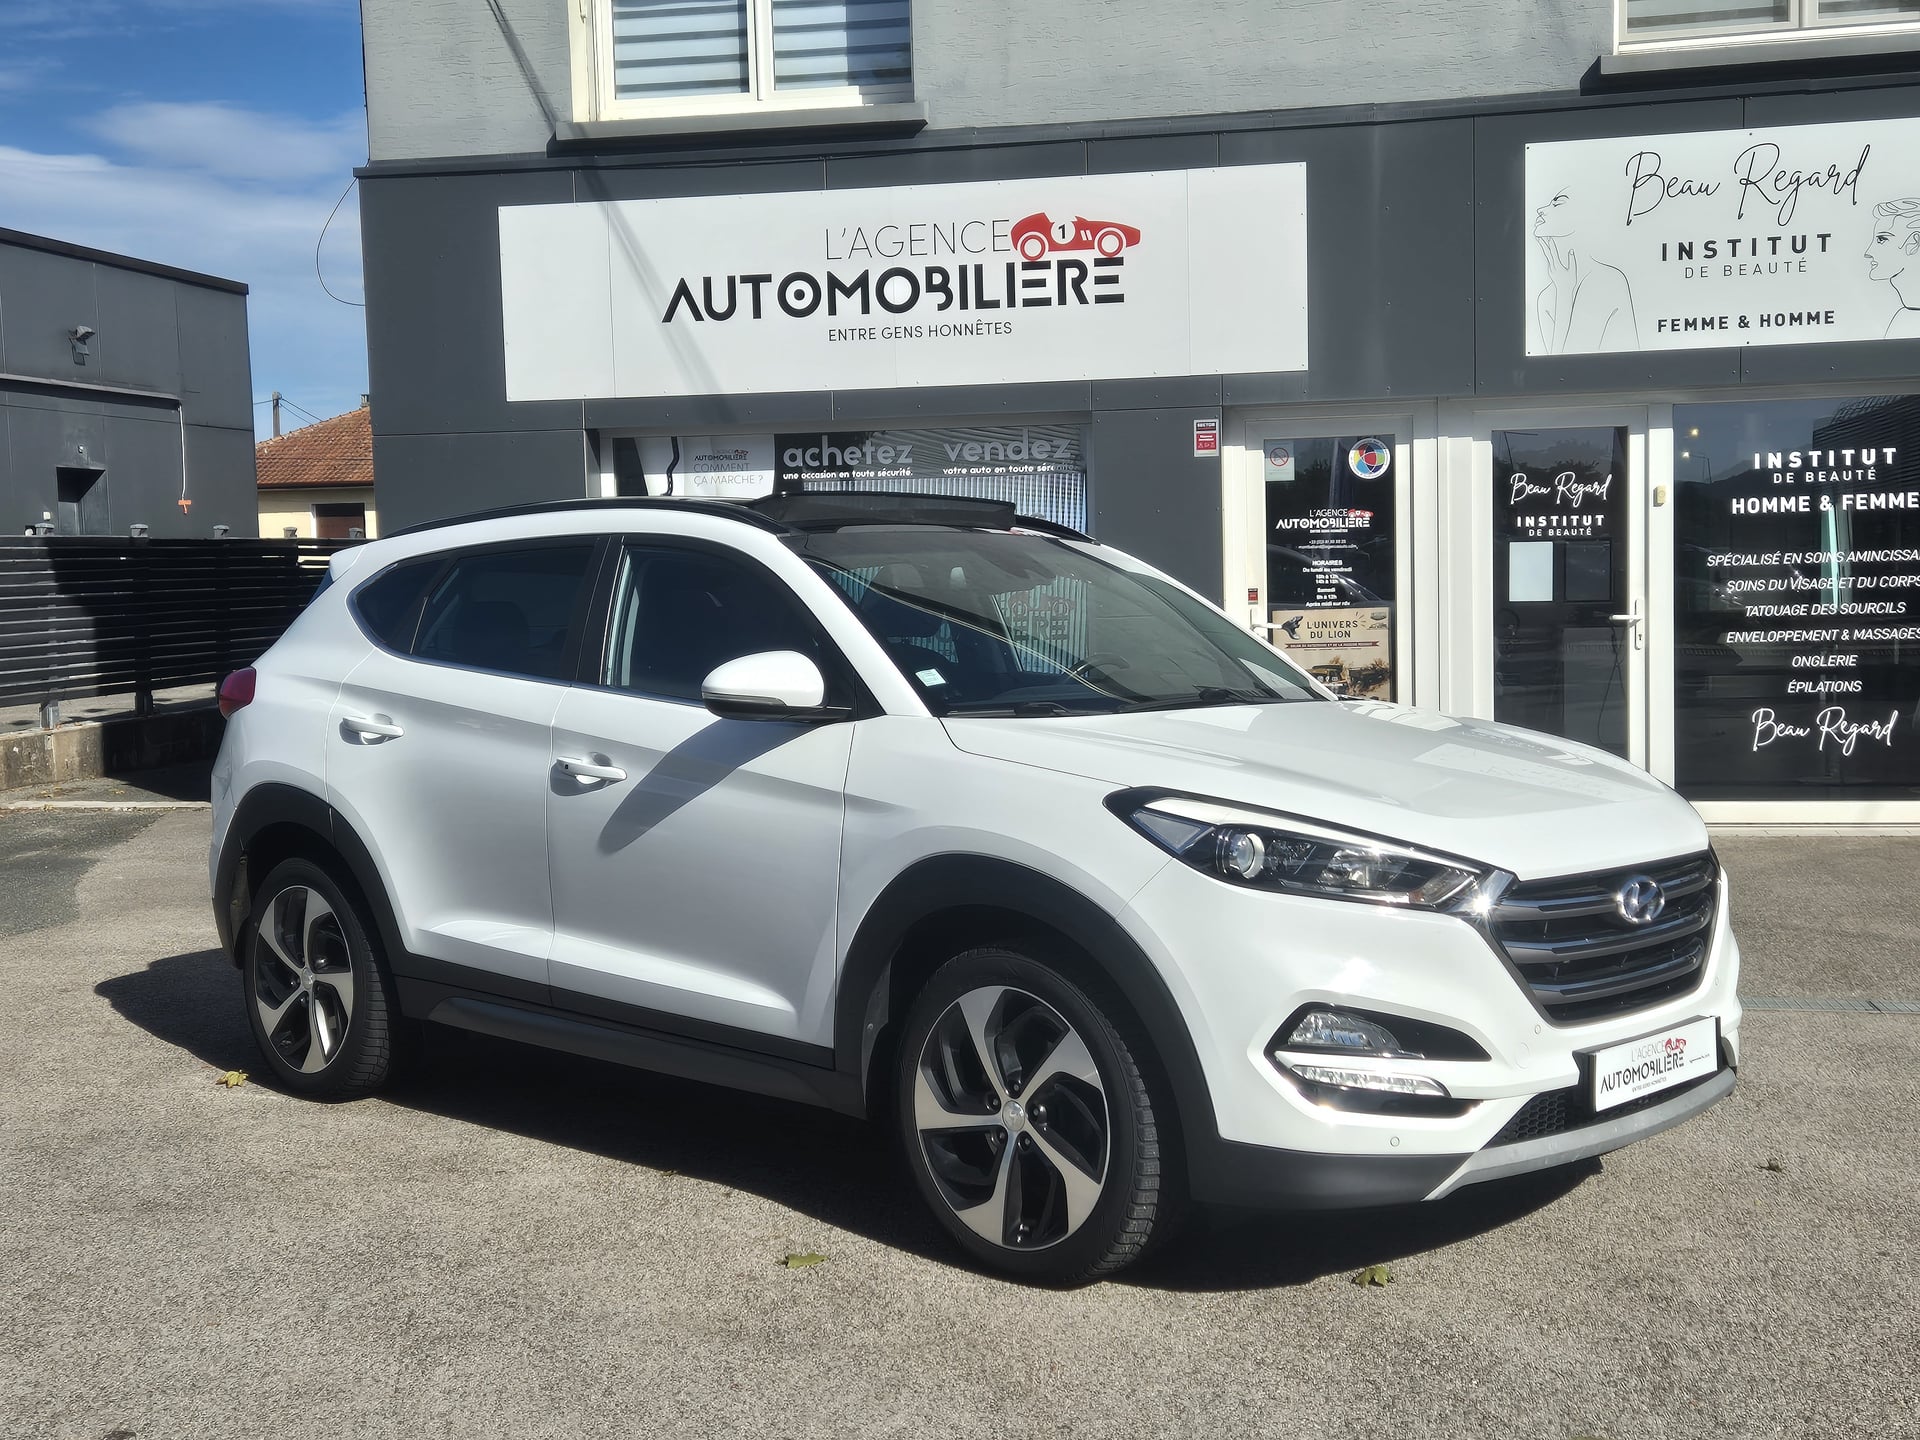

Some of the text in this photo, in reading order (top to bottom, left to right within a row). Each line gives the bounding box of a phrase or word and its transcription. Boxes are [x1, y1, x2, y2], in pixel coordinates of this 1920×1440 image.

[1625, 142, 1871, 227] Beau Regard
[825, 219, 1011, 260] L'AGENCE
[1661, 233, 1832, 262] INSTITUT
[1684, 257, 1808, 279] DE BEAUTÉ
[828, 318, 1013, 342] ENTRE GENS HONNÊTES
[1657, 310, 1836, 333] FEMME & HOMME
[783, 434, 913, 468] achetez
[943, 426, 1072, 462] vendez
[693, 462, 751, 473] COMMENT
[1753, 447, 1897, 470] INSTITUT
[782, 471, 799, 480] une
[800, 469, 837, 480] occasion
[838, 470, 850, 479] en
[851, 469, 875, 478] toute
[942, 466, 968, 475] votre
[969, 464, 992, 474] auto
[994, 465, 1006, 474] en
[1008, 464, 1034, 474] toute
[1773, 466, 1877, 484] DE BEAUTÉ
[693, 475, 708, 487] ÇA
[710, 474, 757, 485] MARCHE
[1510, 471, 1613, 508] Beau Regard
[1731, 491, 1920, 515] HOMME & FEMME
[1516, 514, 1605, 527] INSTITUT
[1528, 527, 1592, 537] DE BEAUTÉ
[1706, 549, 1920, 567] SPÉCIALISÉ EN SOINS AMINCISSA
[1726, 579, 1767, 592] SOINS
[1768, 579, 1788, 591] DU
[1789, 577, 1836, 591] VISAGE
[1838, 577, 1854, 589] ET
[1857, 576, 1877, 588] DU
[1744, 601, 1907, 617] TATOUAGE DES SOURCILS
[1310, 630, 1352, 639] DU LION
[1726, 629, 1840, 643] ENVELOPPEMENT
[1840, 629, 1850, 641] &
[1791, 654, 1858, 667] ONGLERIE
[1787, 679, 1863, 693] ÉPILATIONS
[1751, 706, 1899, 756] Beau Regard
